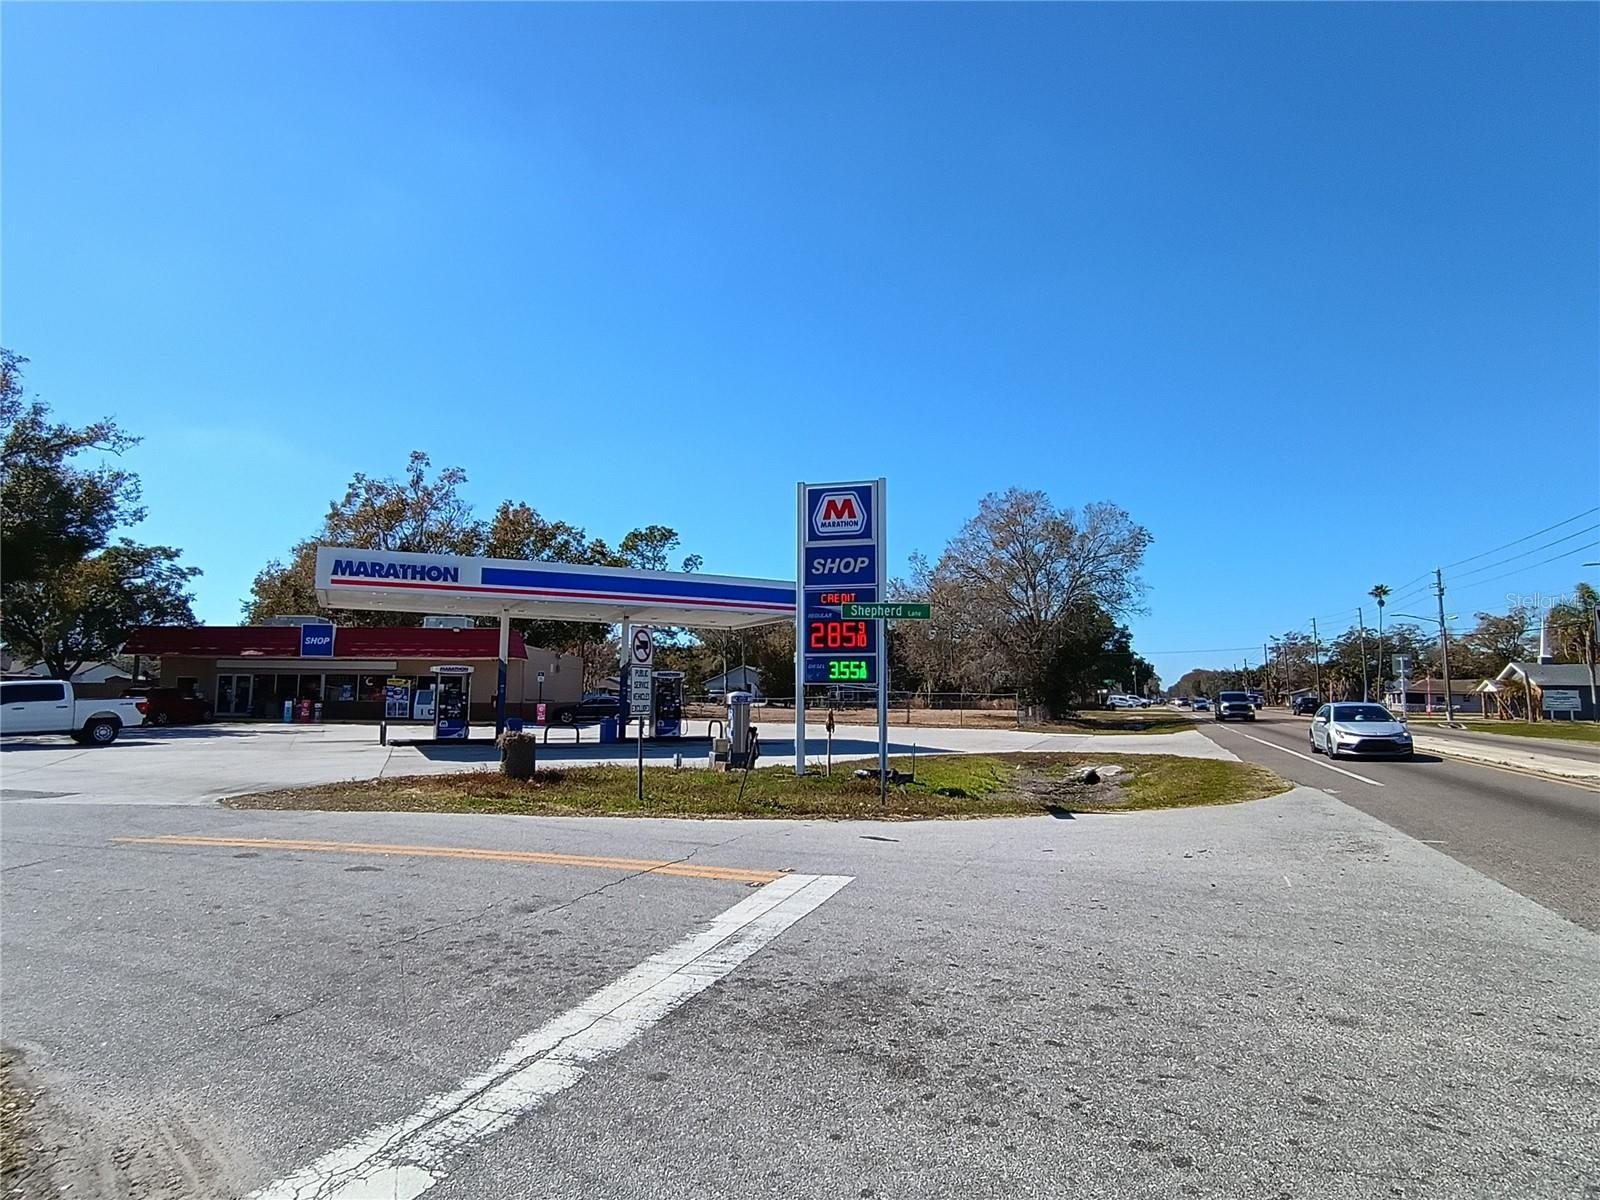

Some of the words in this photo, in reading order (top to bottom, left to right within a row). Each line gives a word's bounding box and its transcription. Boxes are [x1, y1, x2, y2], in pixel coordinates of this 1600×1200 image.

[823, 499, 857, 520] M
[820, 520, 859, 528] MARATHON
[331, 559, 459, 583] MARATHON
[811, 557, 869, 574] SHOP
[820, 593, 856, 604] CREDIT
[850, 605, 902, 618] Shepherd
[304, 637, 330, 645] SHOP
